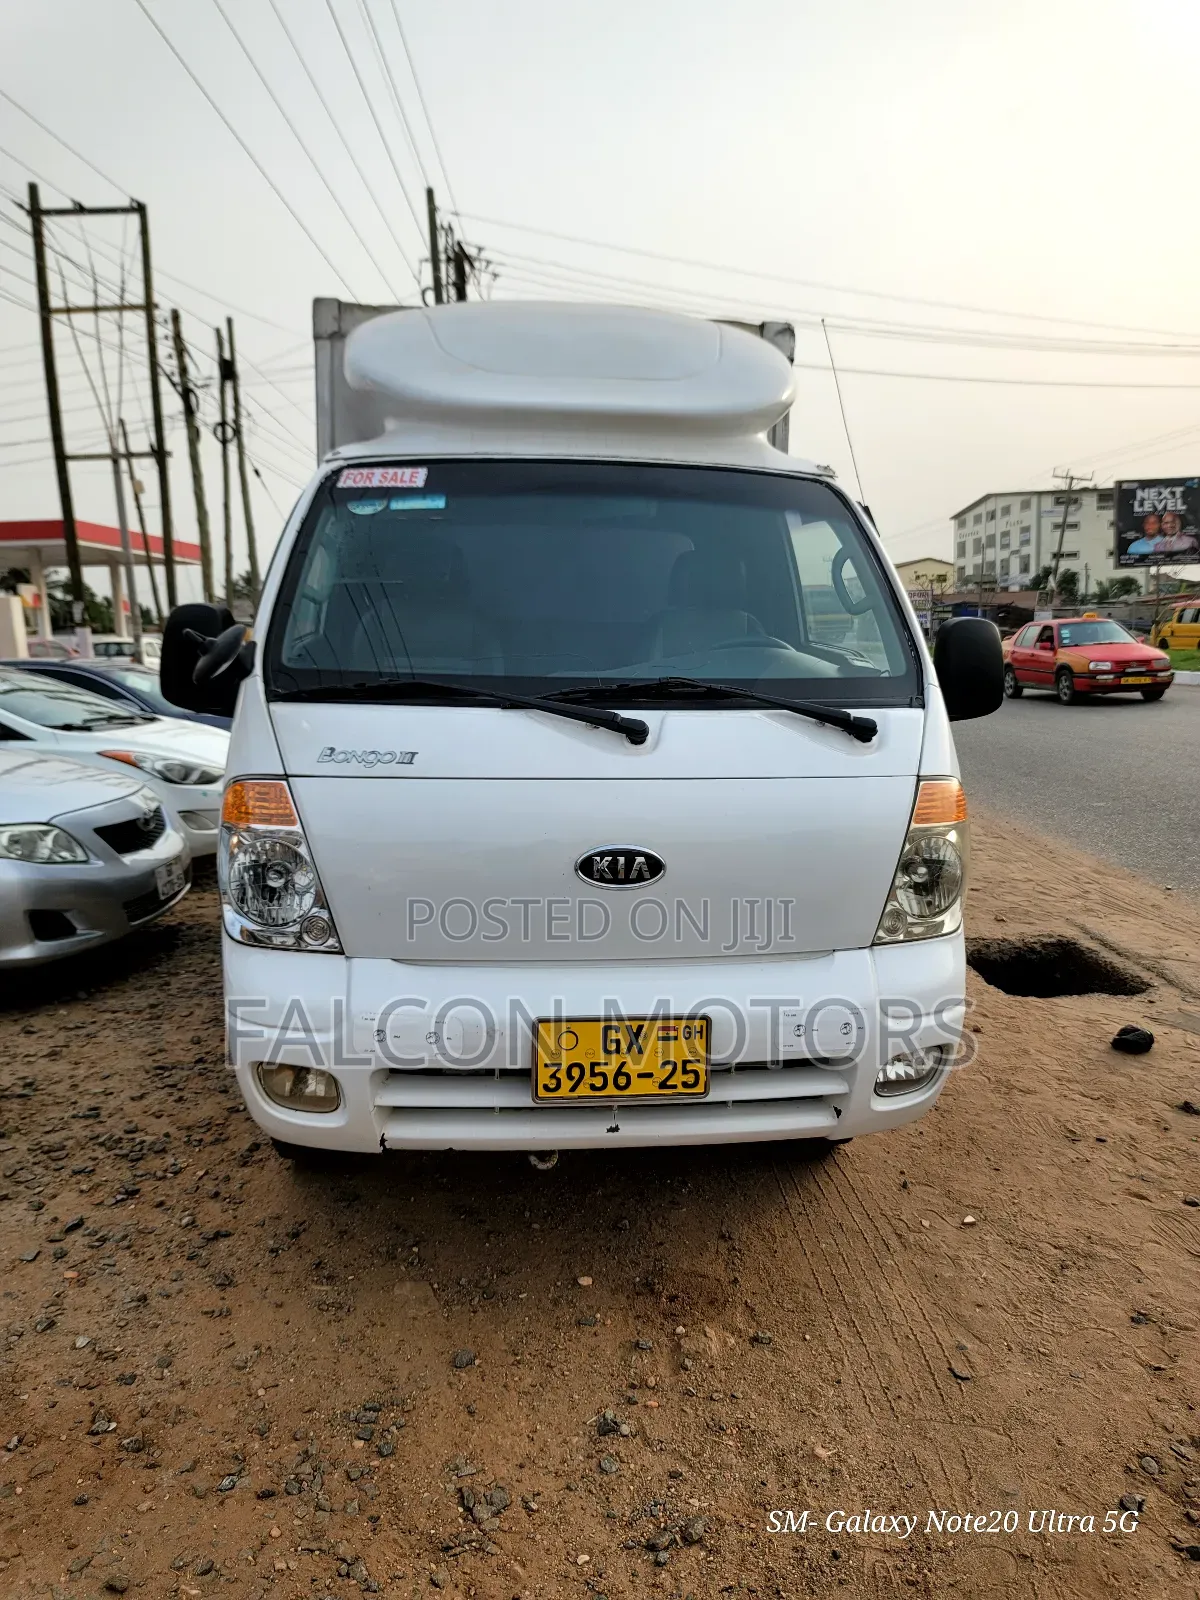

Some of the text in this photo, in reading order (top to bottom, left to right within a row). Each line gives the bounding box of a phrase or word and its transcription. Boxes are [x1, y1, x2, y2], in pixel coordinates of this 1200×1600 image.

[342, 470, 420, 485] FOR SALE
[1135, 487, 1185, 501] NEXT
[1133, 498, 1187, 512] LEVEL
[592, 856, 651, 879] KIA
[601, 1024, 704, 1055] GX GH
[542, 1059, 701, 1093] 3956-25
